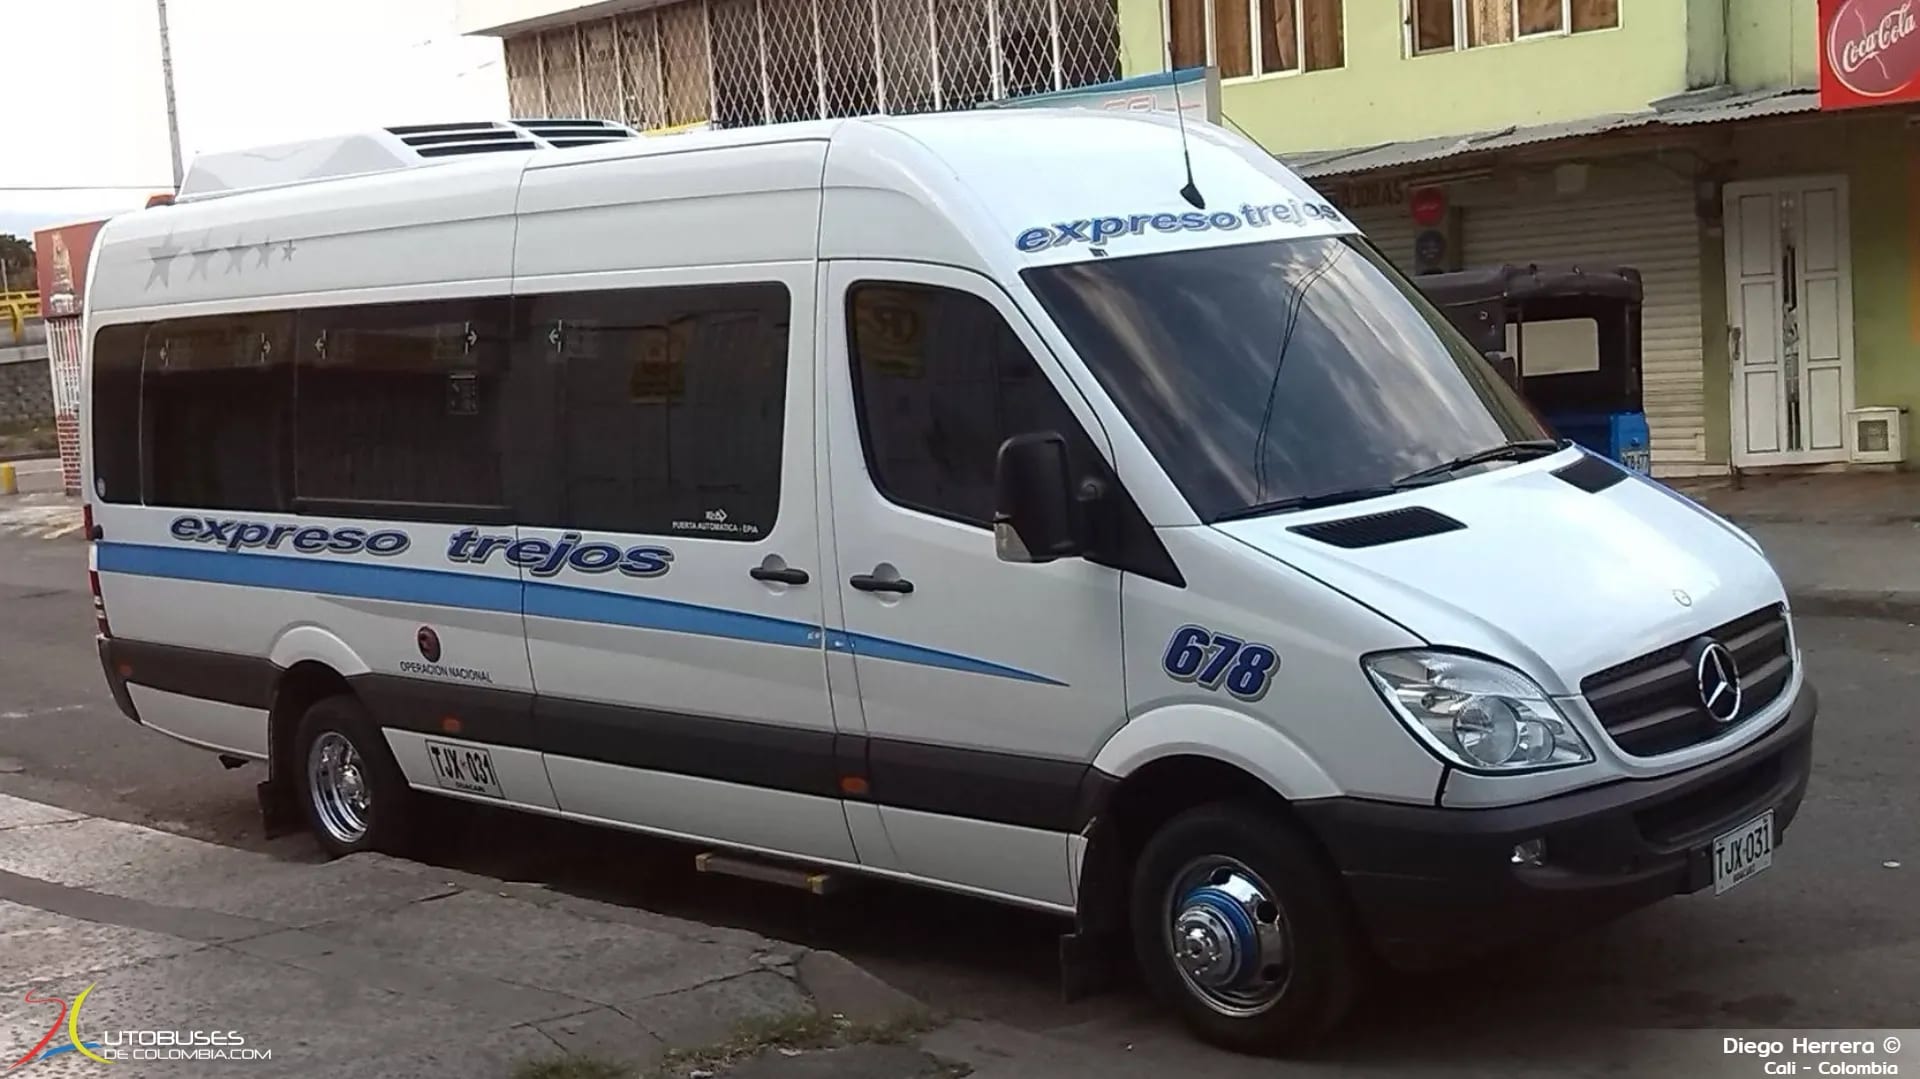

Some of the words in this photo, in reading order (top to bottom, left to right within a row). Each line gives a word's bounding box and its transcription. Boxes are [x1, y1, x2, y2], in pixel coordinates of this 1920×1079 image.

[1842, 3, 1916, 73] Coca-Cola
[1014, 211, 1242, 252] expreso
[1240, 199, 1341, 228] trejos
[169, 513, 410, 556] expreso
[446, 526, 675, 577] trejos
[399, 660, 448, 677] OPERACION
[448, 666, 494, 684] NACIONAL
[1161, 623, 1281, 703] 678
[1715, 823, 1770, 880] TJX-031
